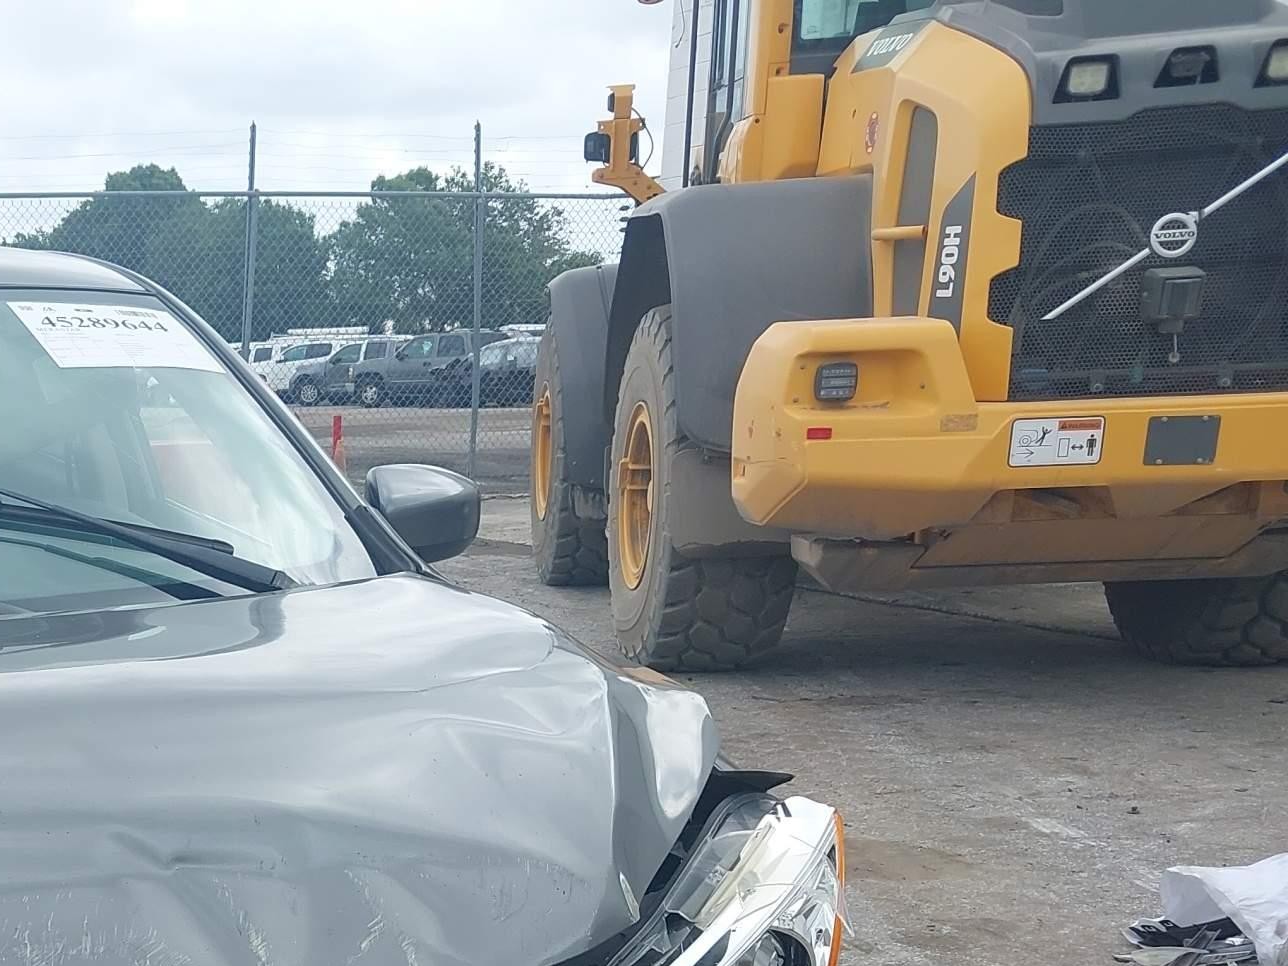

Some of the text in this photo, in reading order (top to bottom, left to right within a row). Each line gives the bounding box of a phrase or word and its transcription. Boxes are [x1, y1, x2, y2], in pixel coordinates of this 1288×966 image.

[866, 32, 914, 57] VOLVO
[1153, 231, 1195, 239] VOLVO
[935, 225, 962, 297] L90H
[41, 315, 169, 332] 45289644
